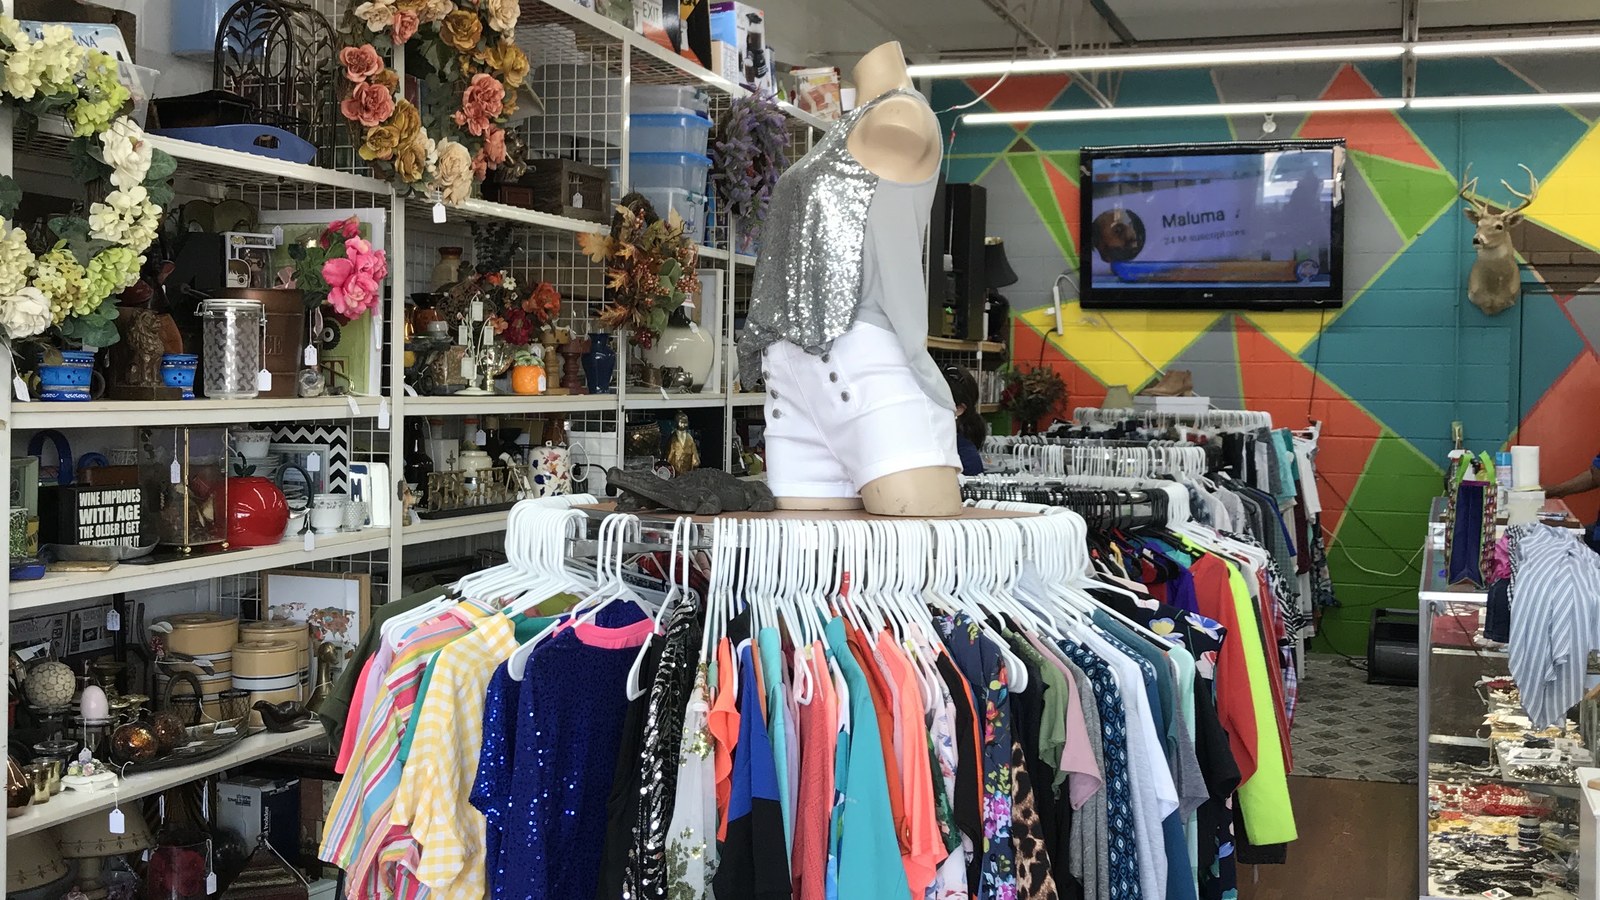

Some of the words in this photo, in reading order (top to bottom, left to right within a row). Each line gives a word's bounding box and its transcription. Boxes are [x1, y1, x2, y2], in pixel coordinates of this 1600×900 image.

[643, 2, 659, 22] EXIT
[1162, 210, 1225, 228] Maluma
[79, 492, 100, 506] WINE
[101, 489, 141, 504] IMPROVES
[79, 506, 114, 525] WITH
[116, 504, 141, 521] AGE
[79, 525, 94, 539] THE
[95, 523, 120, 537] OLDER
[121, 522, 124, 534] I
[126, 521, 140, 533] GET
